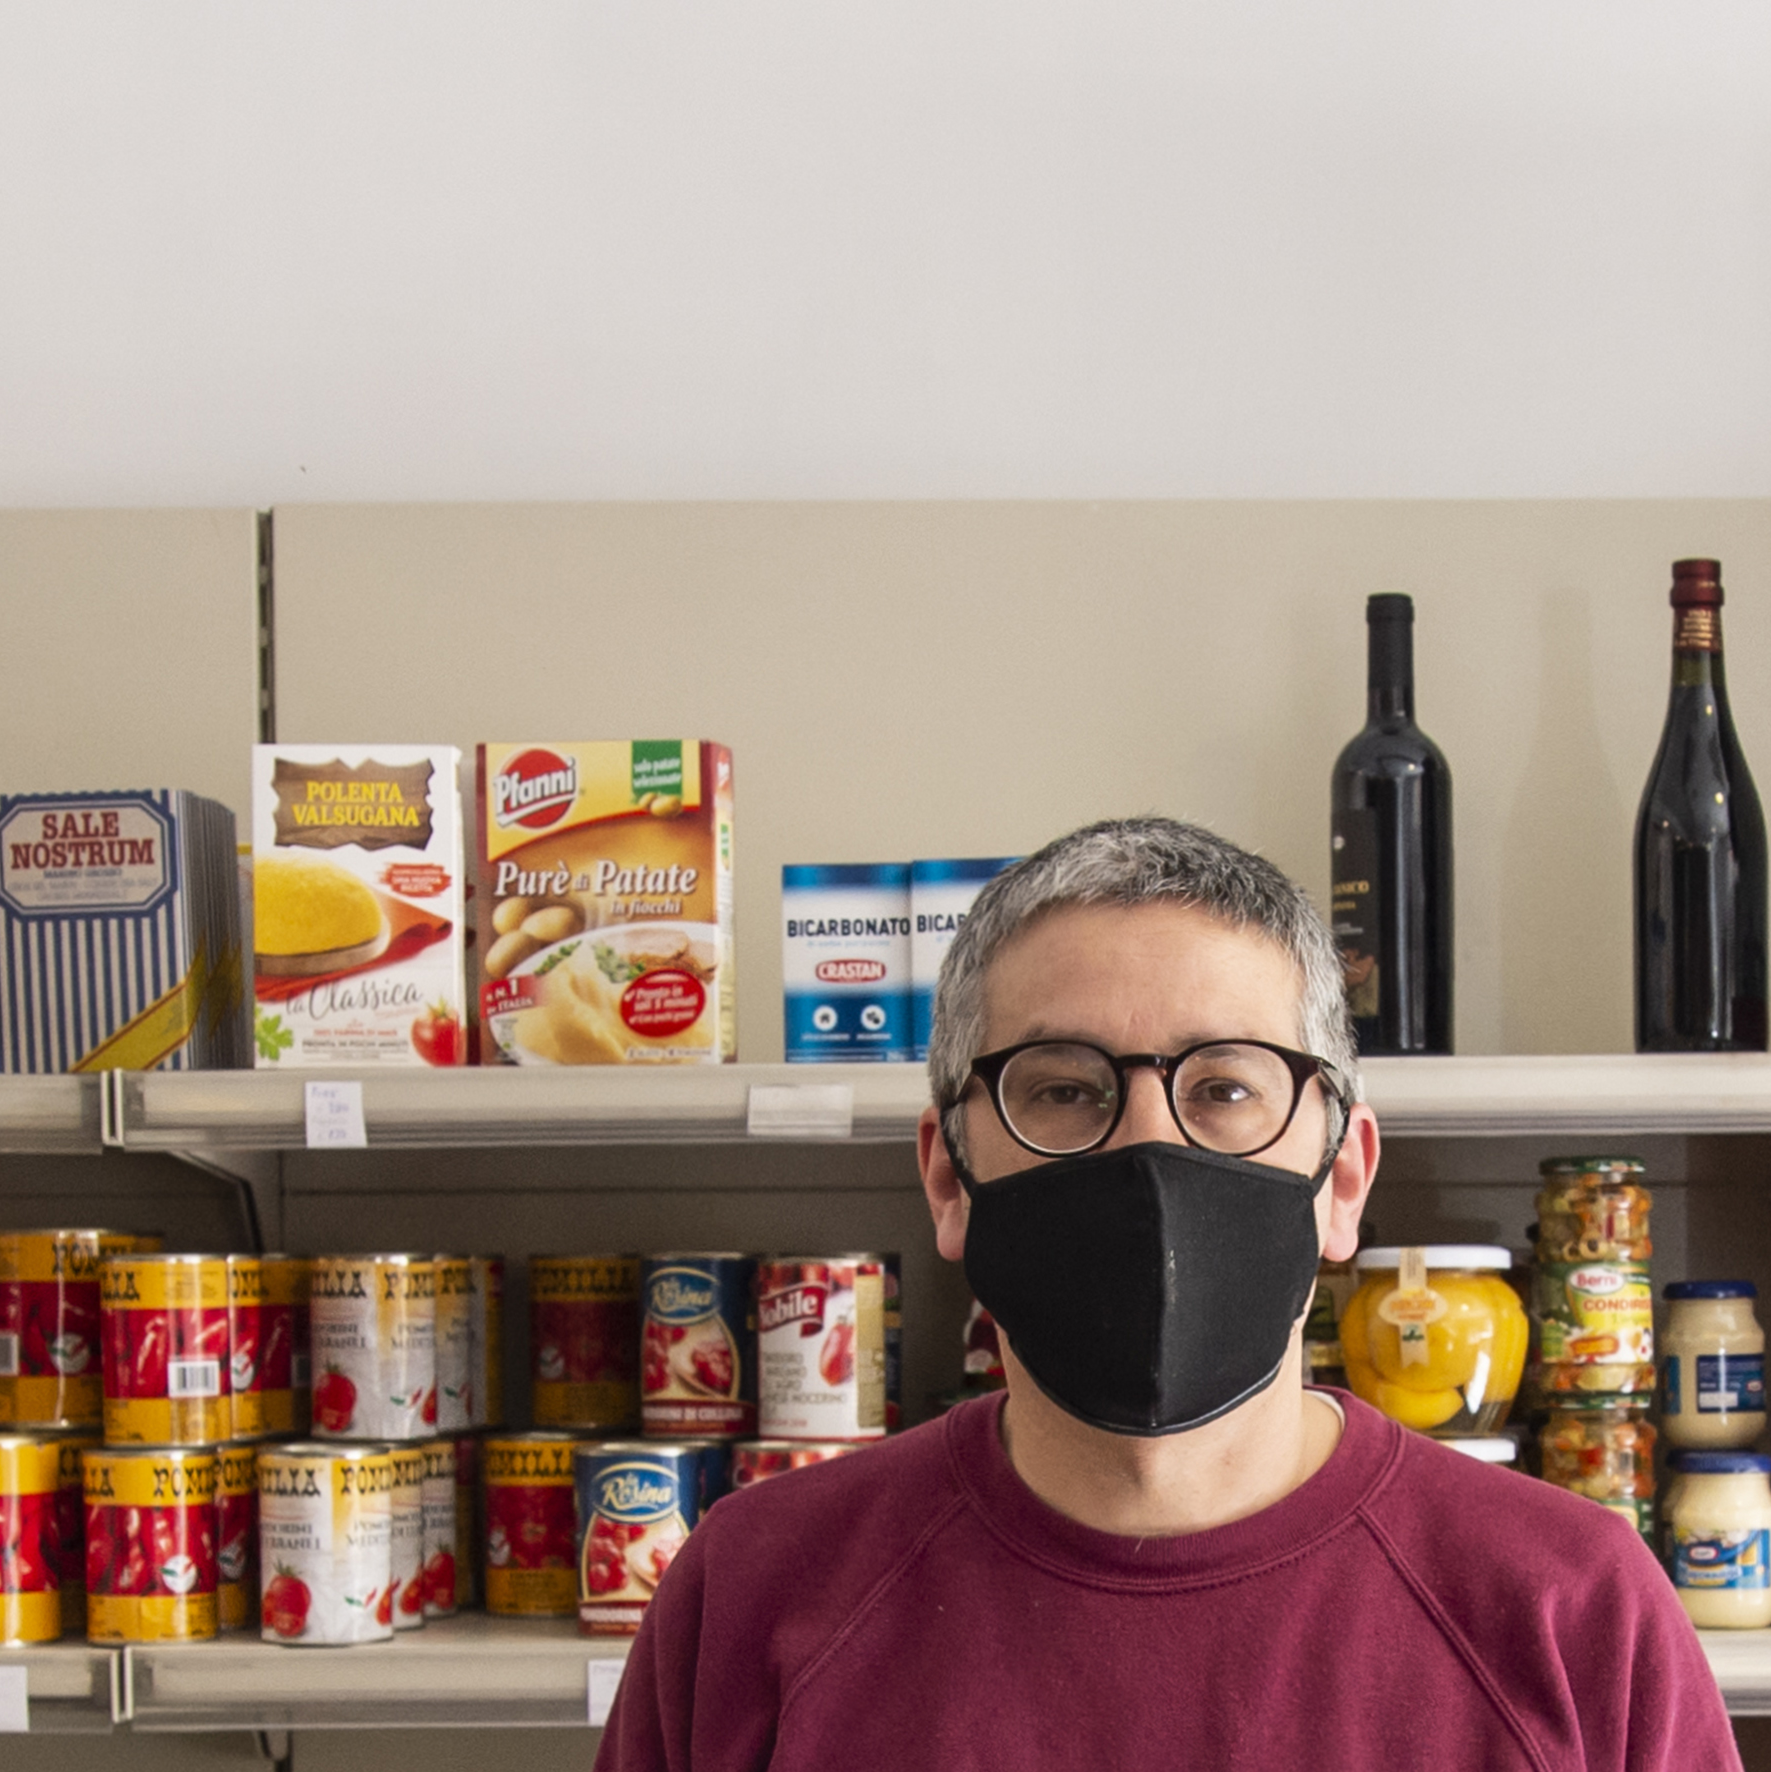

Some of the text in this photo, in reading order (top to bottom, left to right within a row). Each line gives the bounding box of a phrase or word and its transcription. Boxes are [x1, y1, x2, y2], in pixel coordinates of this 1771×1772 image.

[306, 781, 404, 803] POLENTA
[494, 757, 574, 813] Pfanni
[42, 812, 120, 840] SALE
[292, 804, 420, 827] VALSUGANA
[10, 838, 156, 870] NOSTRUM
[494, 861, 570, 896] Purè
[594, 860, 697, 896] Patate
[611, 898, 682, 918] in fiocchi
[787, 917, 911, 938] BICARBONATO
[818, 962, 882, 979] CRASTAN
[307, 978, 423, 1022] Classica
[1576, 1273, 1618, 1289] Berni
